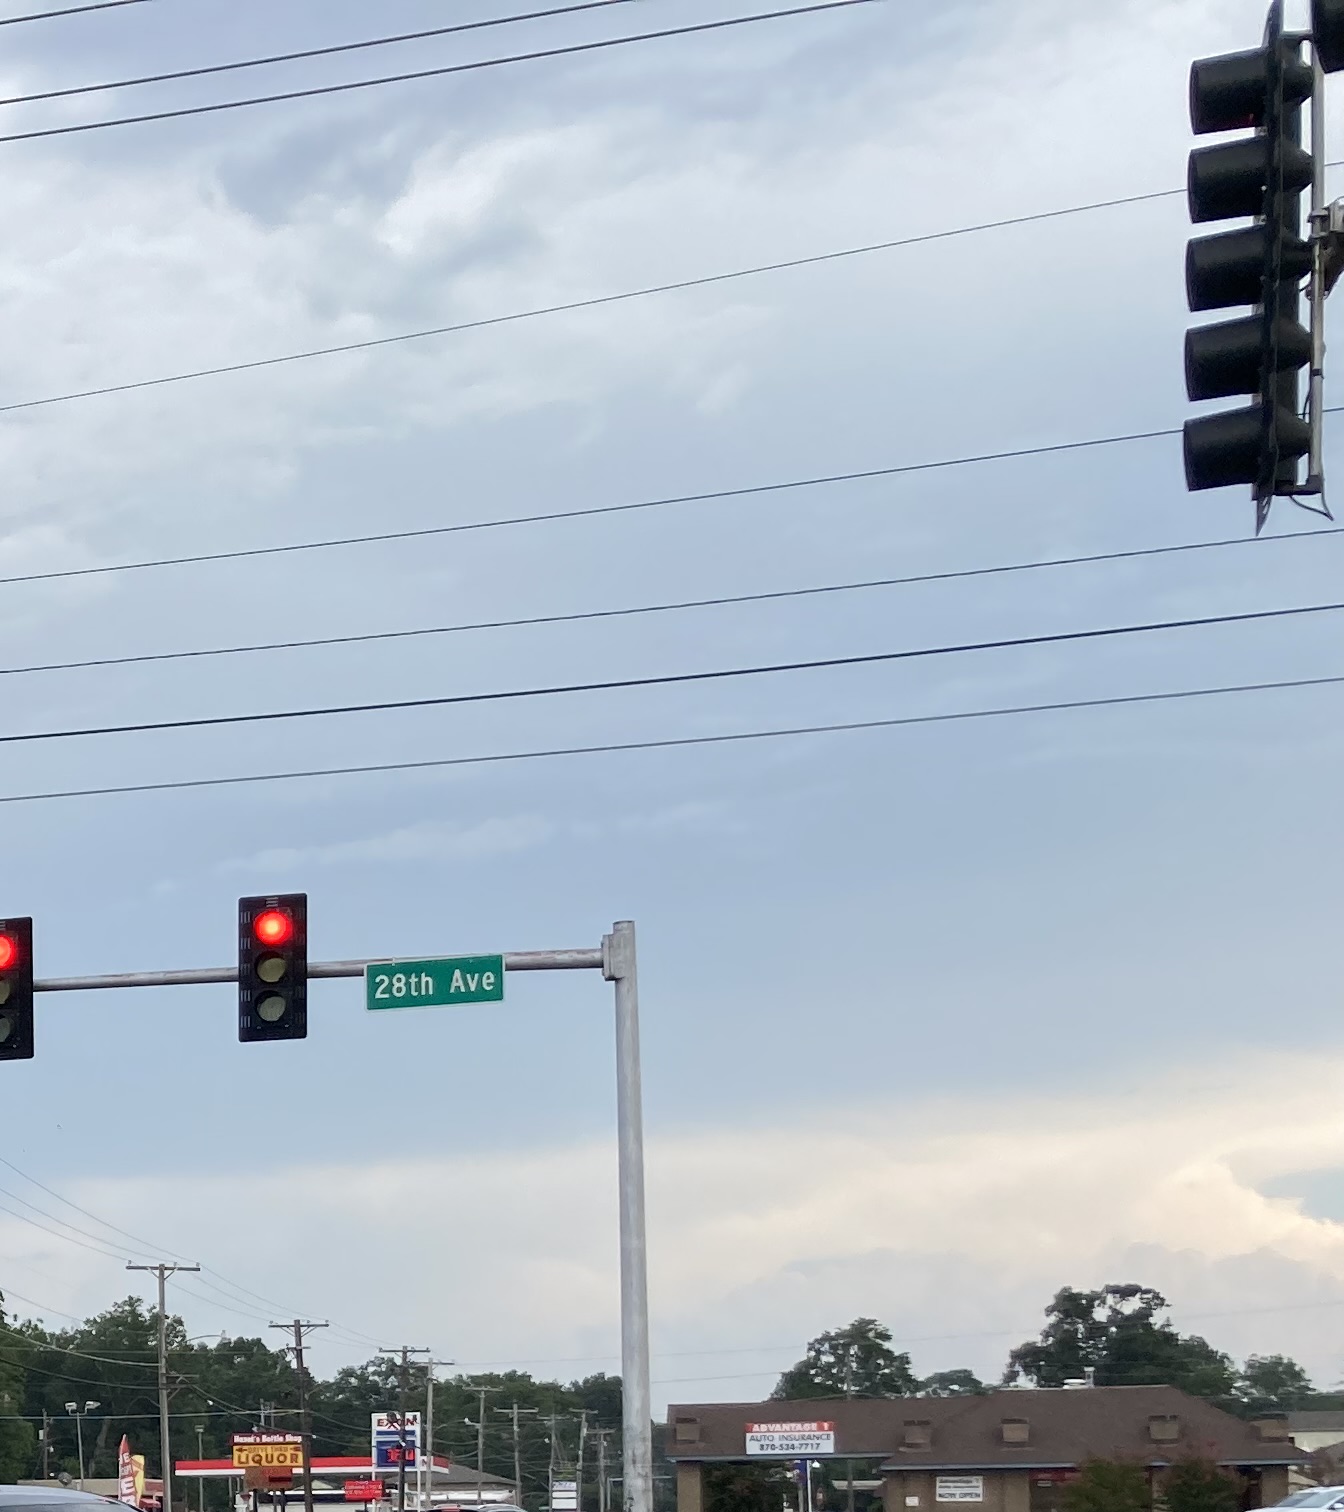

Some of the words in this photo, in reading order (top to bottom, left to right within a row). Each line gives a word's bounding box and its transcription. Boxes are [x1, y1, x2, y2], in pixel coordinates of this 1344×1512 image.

[374, 972, 433, 999] 28th
[449, 969, 495, 993] Ave
[751, 1423, 817, 1432] ADVANTAGE
[822, 1422, 830, 1431] 1
[749, 1434, 774, 1442] AUTO
[778, 1433, 831, 1441] INSURANCE
[759, 1443, 821, 1452] 870-534-7717
[237, 1453, 299, 1467] LIQUOR
